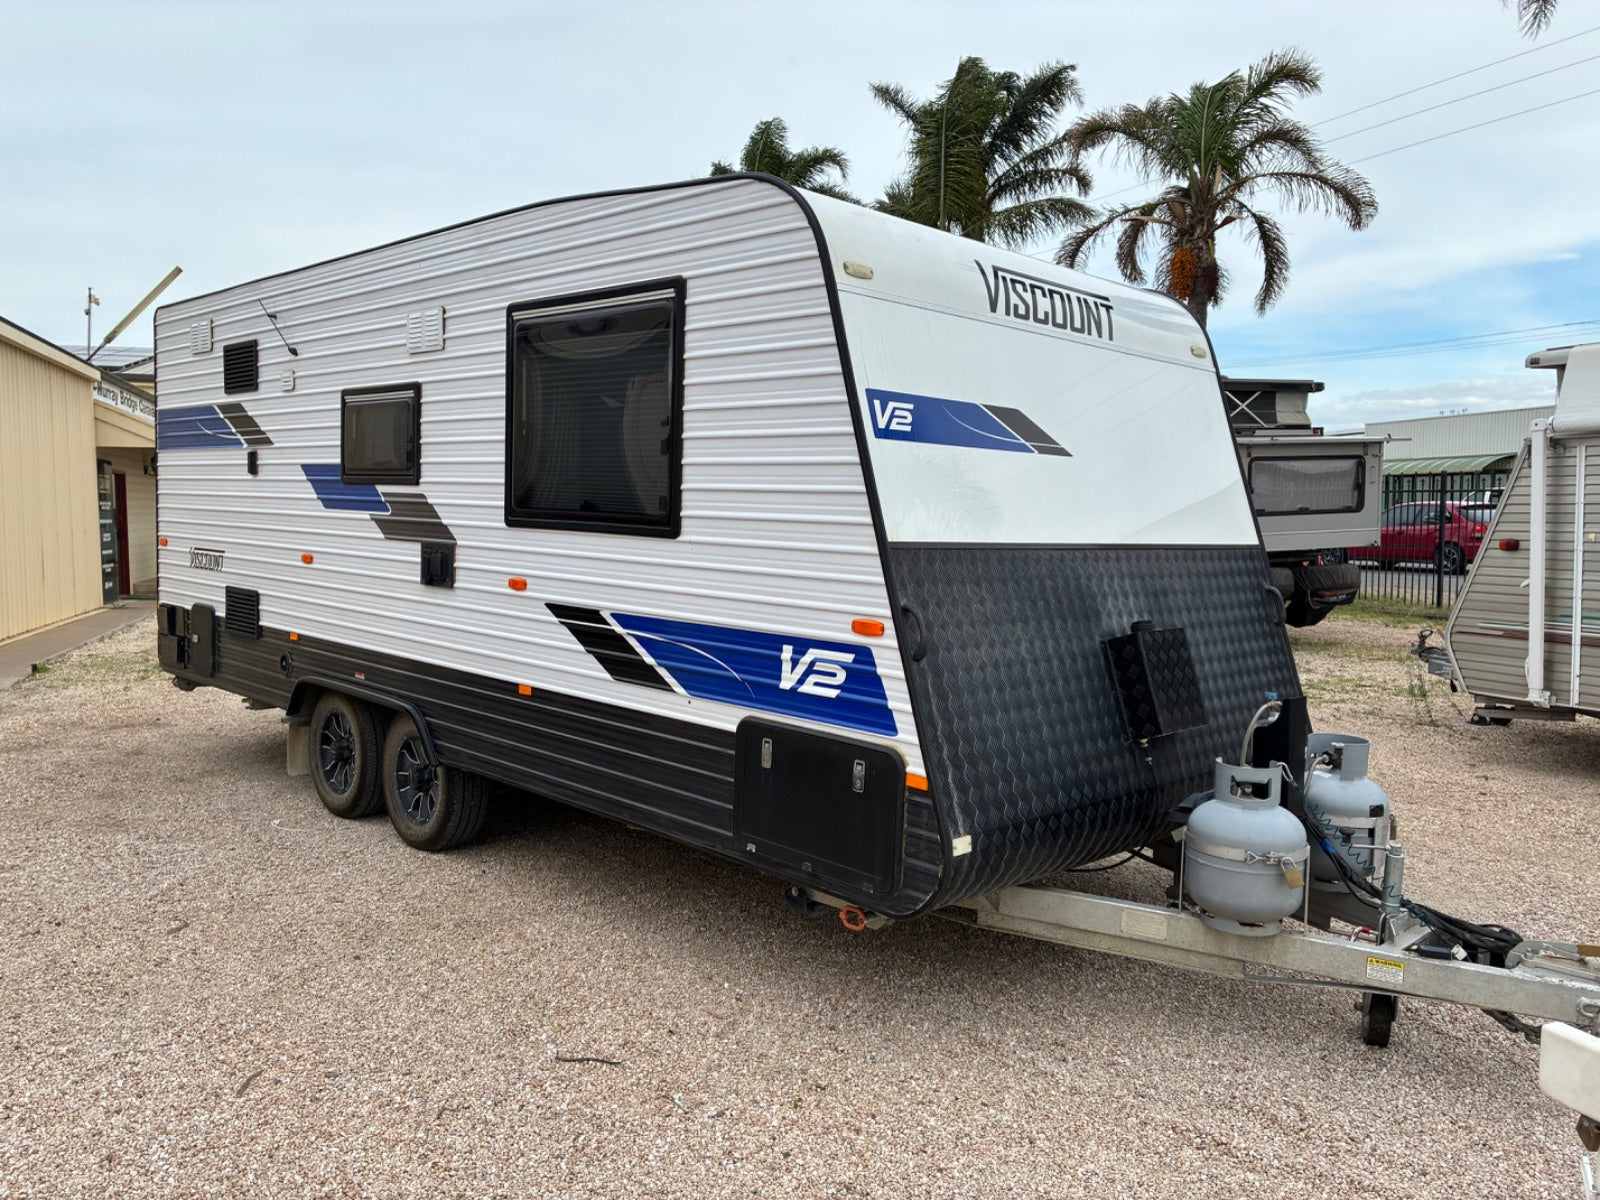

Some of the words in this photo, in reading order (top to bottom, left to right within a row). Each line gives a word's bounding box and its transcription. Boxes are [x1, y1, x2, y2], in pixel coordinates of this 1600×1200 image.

[974, 259, 1114, 342] VISCOUNT
[97, 383, 119, 406] Murray
[120, 390, 138, 413] Bridge
[873, 399, 914, 432] V2
[189, 547, 225, 572] VISCOUNT
[779, 644, 855, 699] V2
